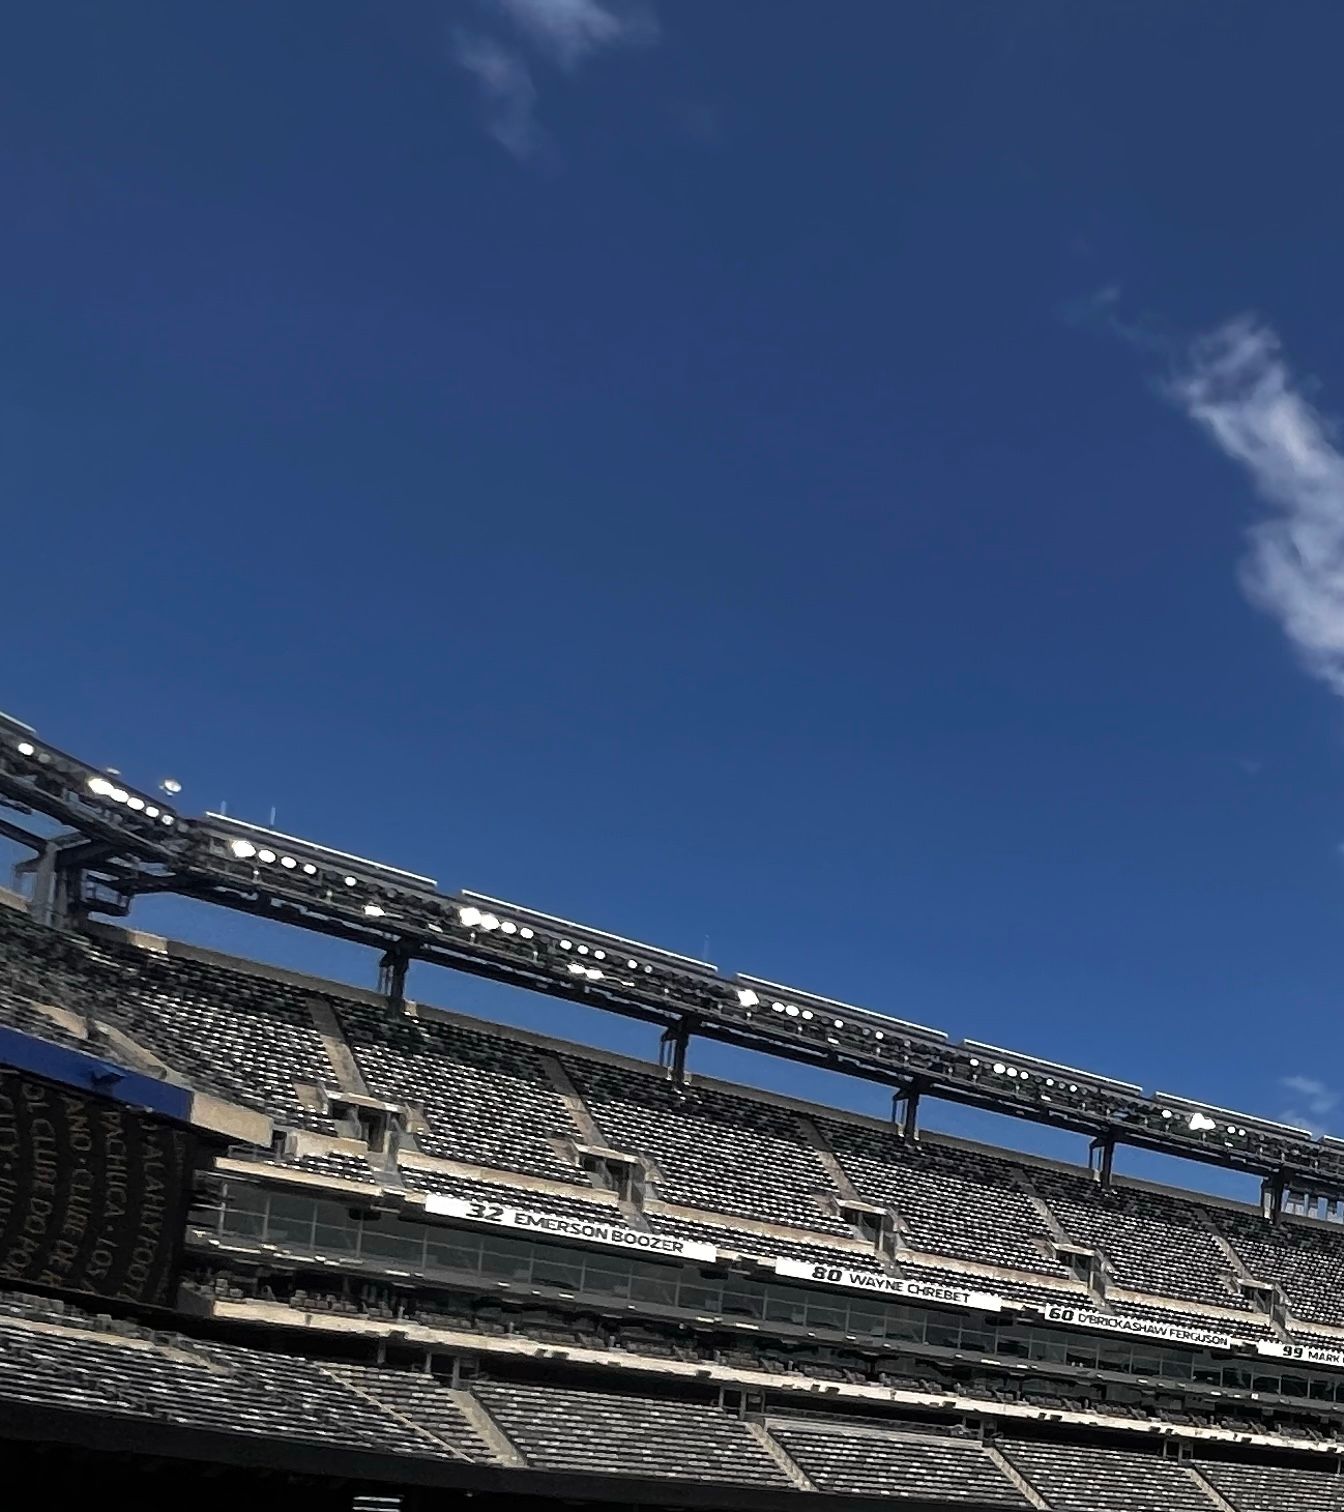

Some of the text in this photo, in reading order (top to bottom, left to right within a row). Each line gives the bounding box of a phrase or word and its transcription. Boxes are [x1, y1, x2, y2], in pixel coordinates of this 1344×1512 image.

[465, 1202, 685, 1254] 32 EMERSON BOOZER
[811, 1267, 970, 1303] 80 WAYNE CHREBET
[1048, 1307, 1228, 1346] 60 D'BRICKASHAW FERGUSON
[1282, 1346, 1303, 1358] 99
[1308, 1350, 1340, 1363] MARK
